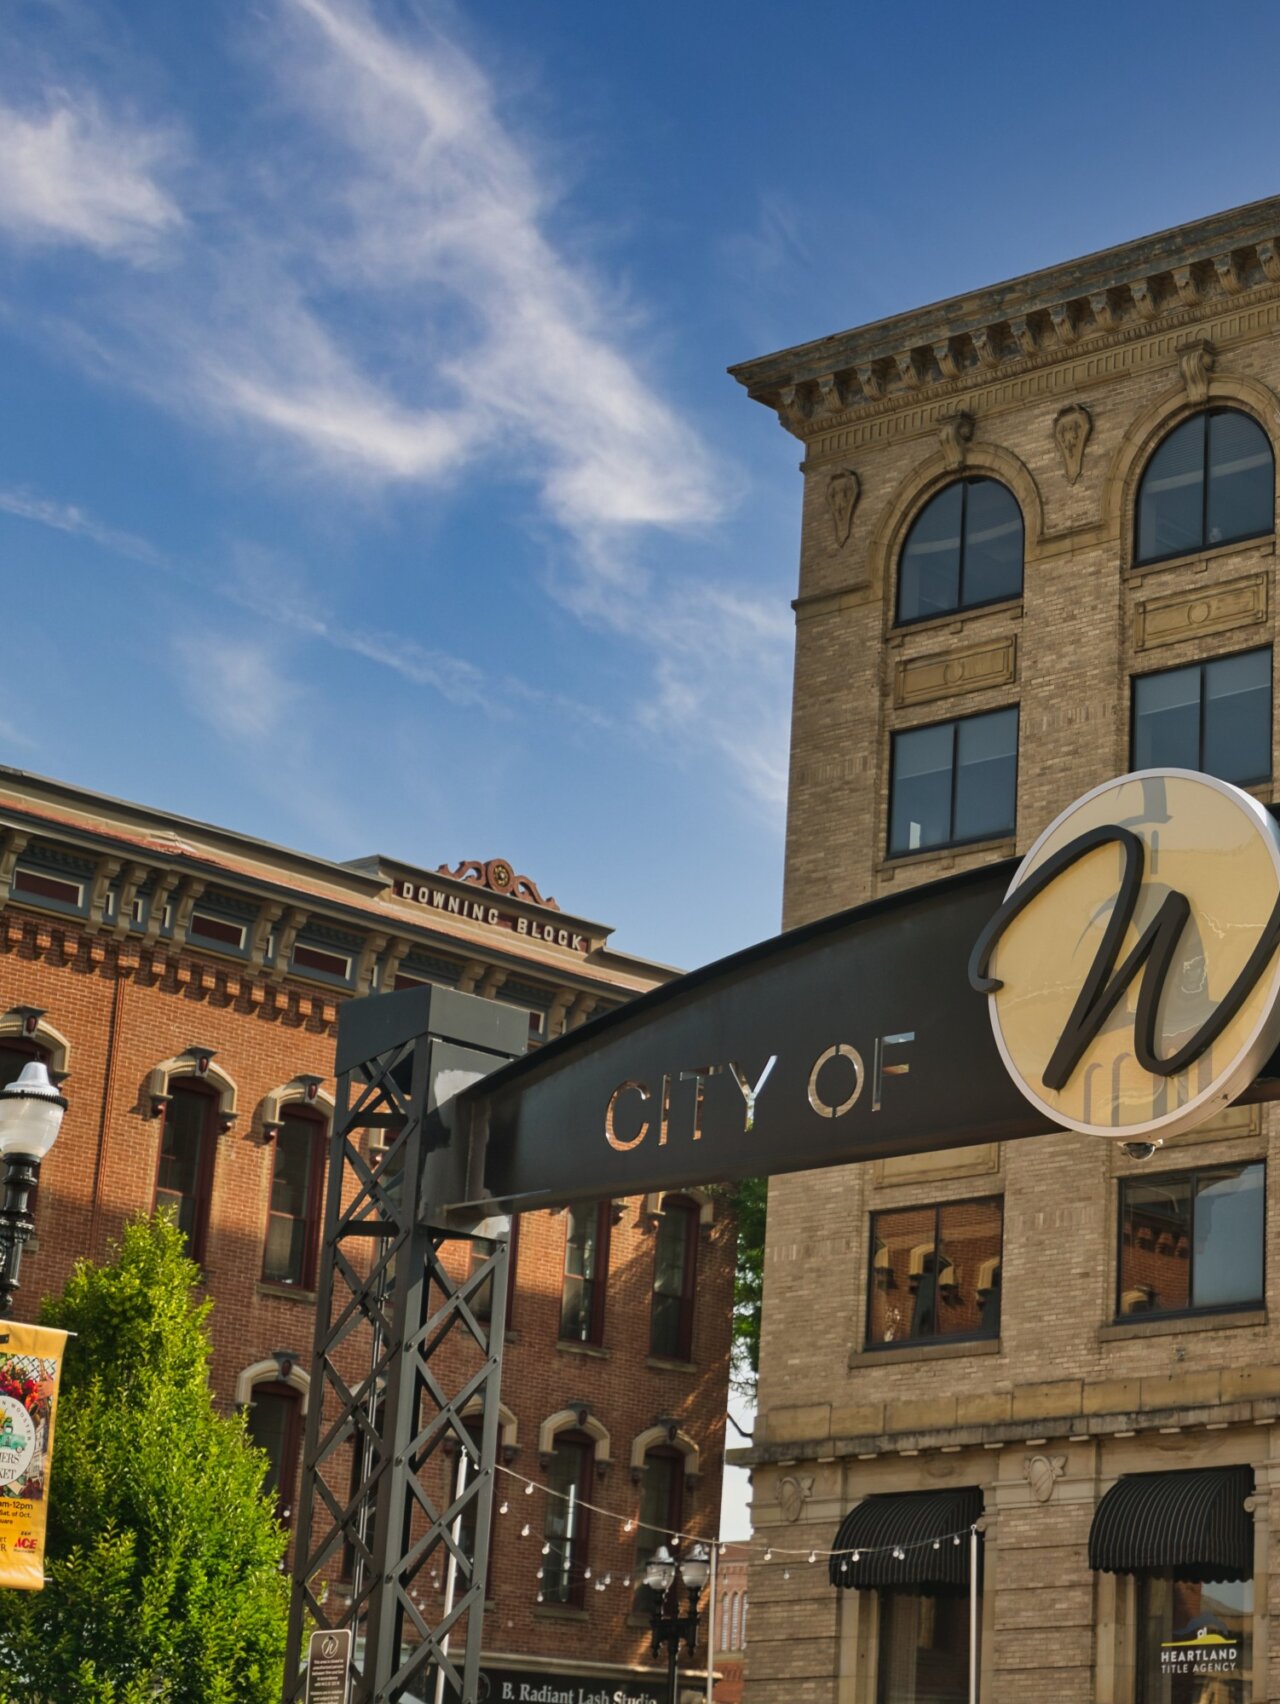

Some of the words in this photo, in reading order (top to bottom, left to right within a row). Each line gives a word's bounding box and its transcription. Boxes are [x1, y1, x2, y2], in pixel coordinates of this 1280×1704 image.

[402, 882, 499, 925] DOWNING
[517, 917, 583, 950] BLOCK
[605, 1055, 778, 1151] CITY
[808, 1031, 915, 1118] OF
[14, 1537, 38, 1549] ACE
[1161, 1648, 1237, 1663] HEARTLAND
[1161, 1664, 1188, 1674] TITLE
[1192, 1662, 1236, 1673] AGENCY
[502, 1682, 515, 1700] B.
[519, 1682, 574, 1704] Radiant
[578, 1688, 610, 1704] Lash
